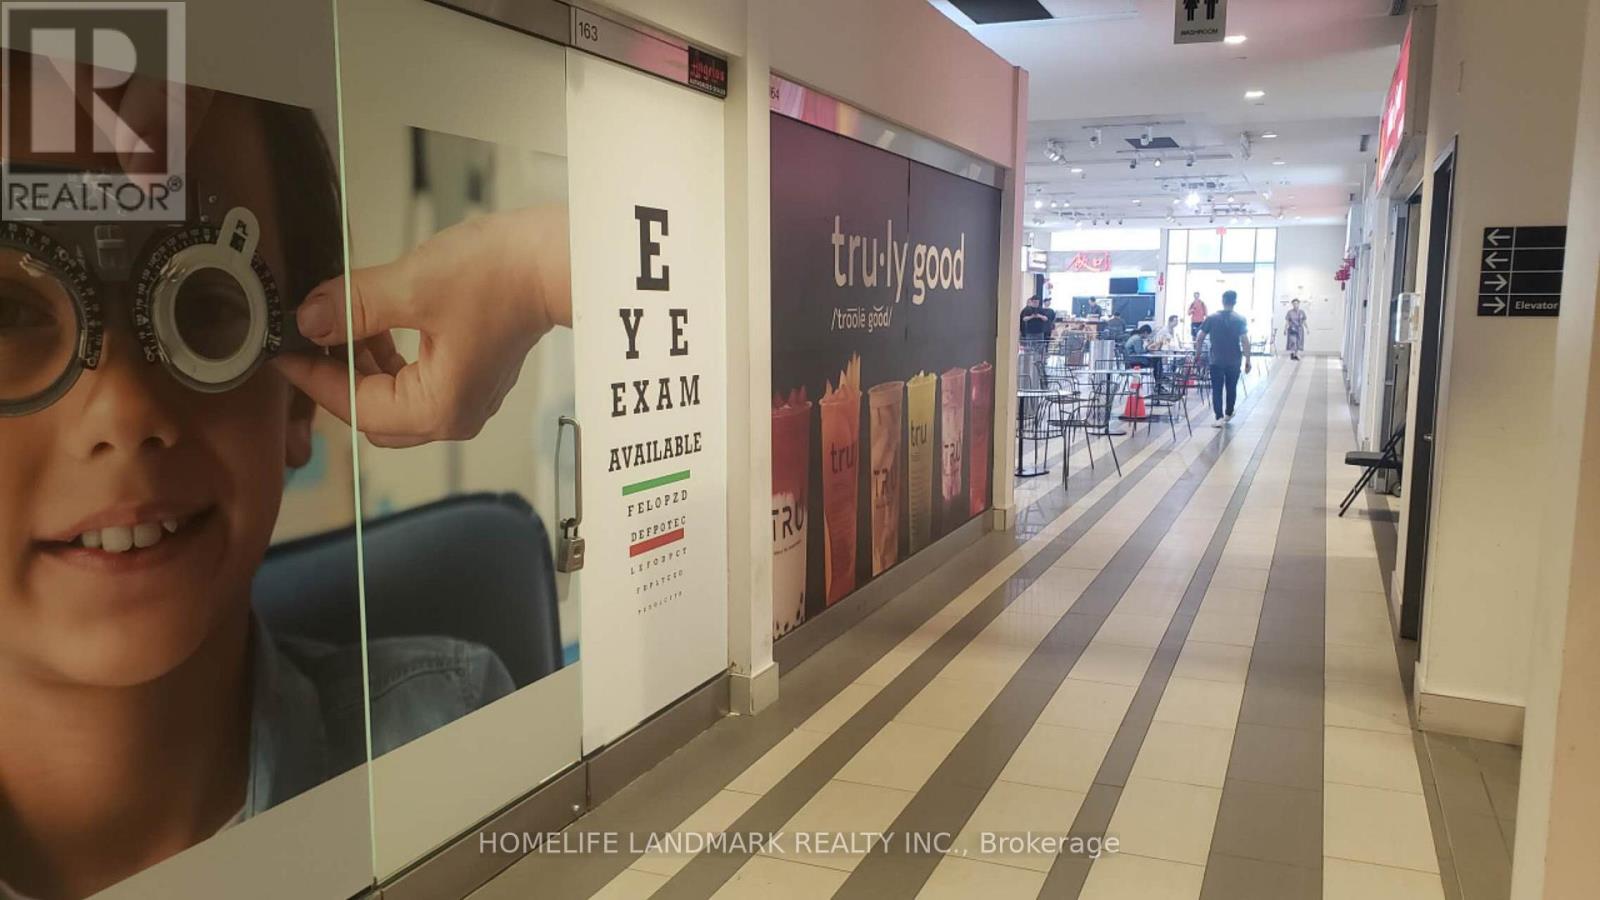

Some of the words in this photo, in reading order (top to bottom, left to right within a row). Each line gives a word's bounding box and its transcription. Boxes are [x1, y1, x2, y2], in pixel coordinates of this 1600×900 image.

[578, 21, 598, 42] 163
[634, 204, 670, 292] E
[912, 231, 965, 305] good
[1515, 300, 1559, 310] Elevator
[611, 374, 701, 418] EXAM
[911, 420, 928, 447] tru
[608, 431, 702, 473] AVAILABLE
[830, 441, 855, 474] tru
[627, 489, 688, 517] FELOPZD
[631, 515, 687, 542] DEFPOTEC
[772, 501, 804, 541] TRU
